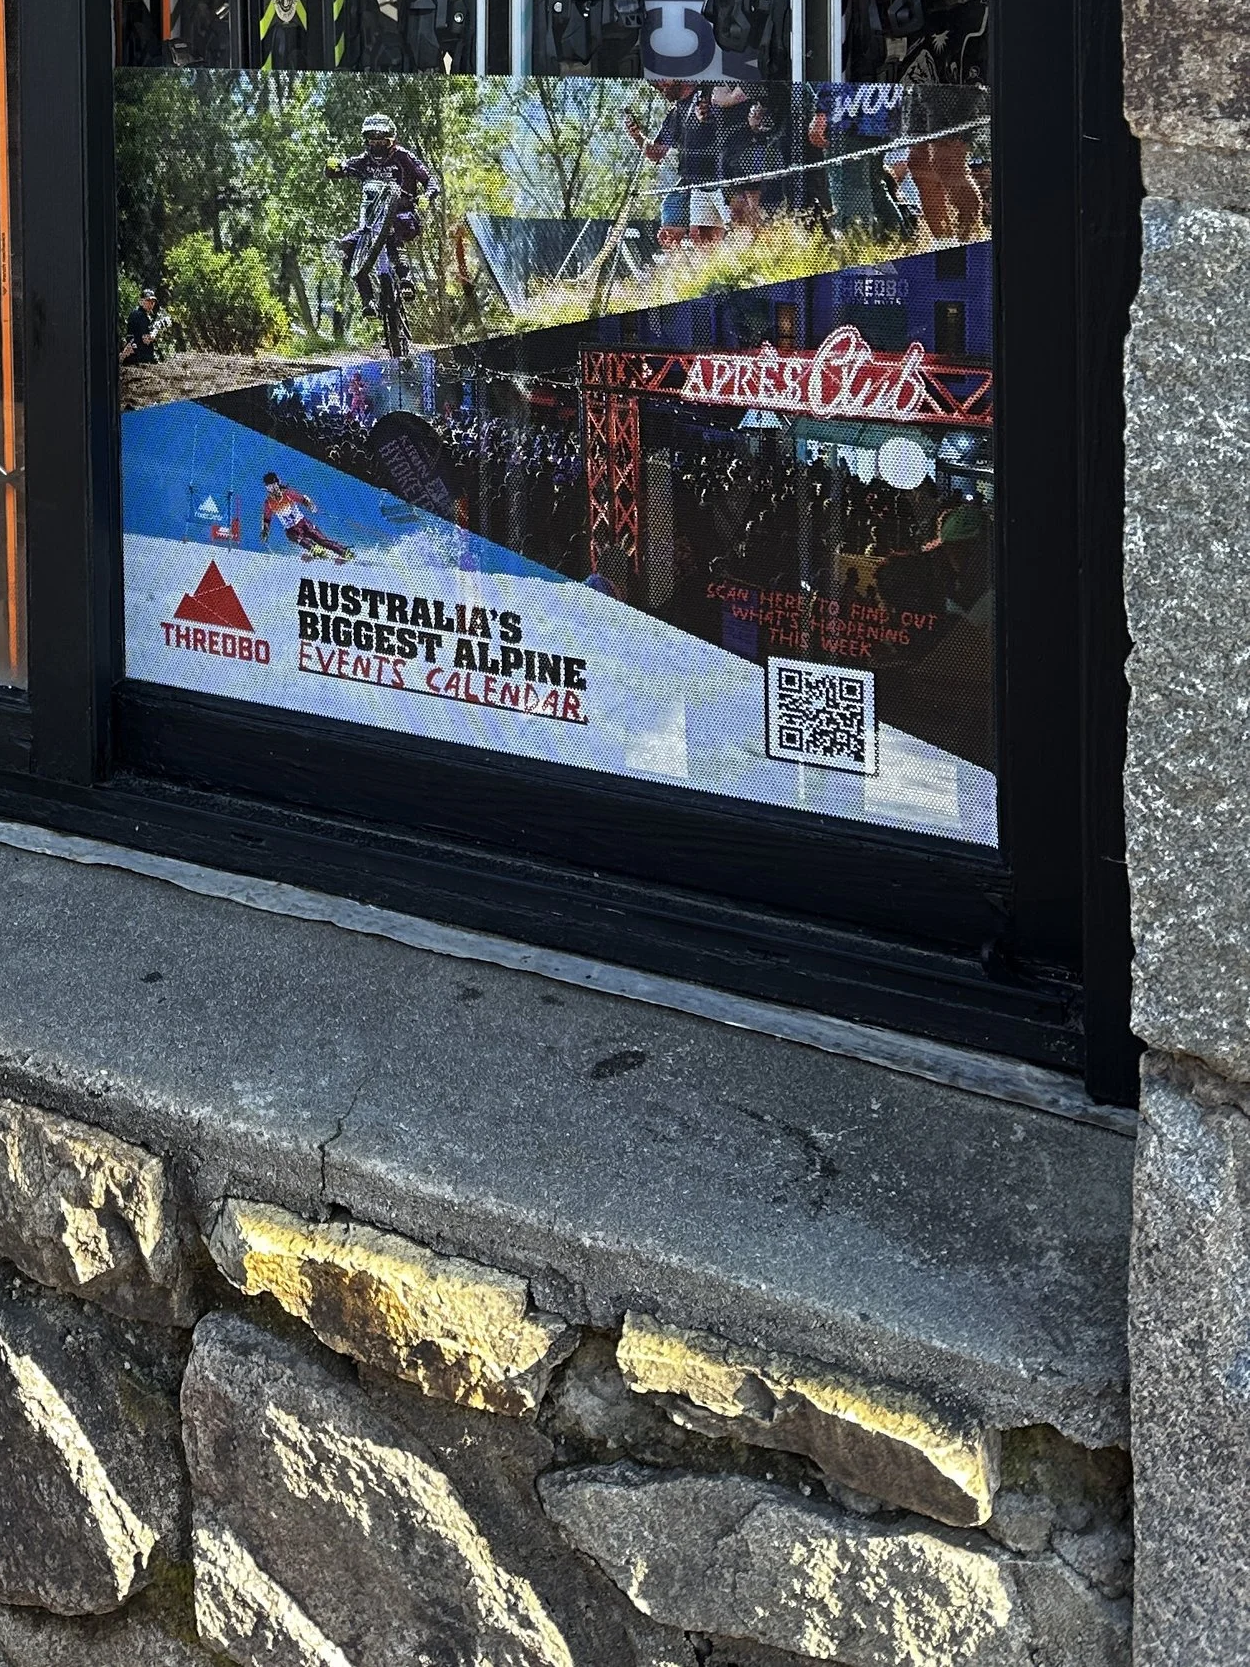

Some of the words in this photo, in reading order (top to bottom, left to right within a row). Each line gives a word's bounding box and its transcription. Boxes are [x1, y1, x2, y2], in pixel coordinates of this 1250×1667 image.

[296, 578, 522, 645] AUSTRALIA'S
[705, 582, 749, 602] SCAN
[760, 591, 806, 613] HERE
[817, 598, 840, 616] TO
[851, 603, 890, 624] FIND
[901, 611, 938, 631] OUT
[810, 615, 911, 646] HAPPENING
[160, 621, 271, 666] THREDBO
[298, 609, 442, 665] BIGGEST
[453, 641, 588, 690] ALPINE
[298, 639, 407, 689] EVENTS
[768, 627, 810, 649] THIS
[821, 637, 873, 658] WEEK
